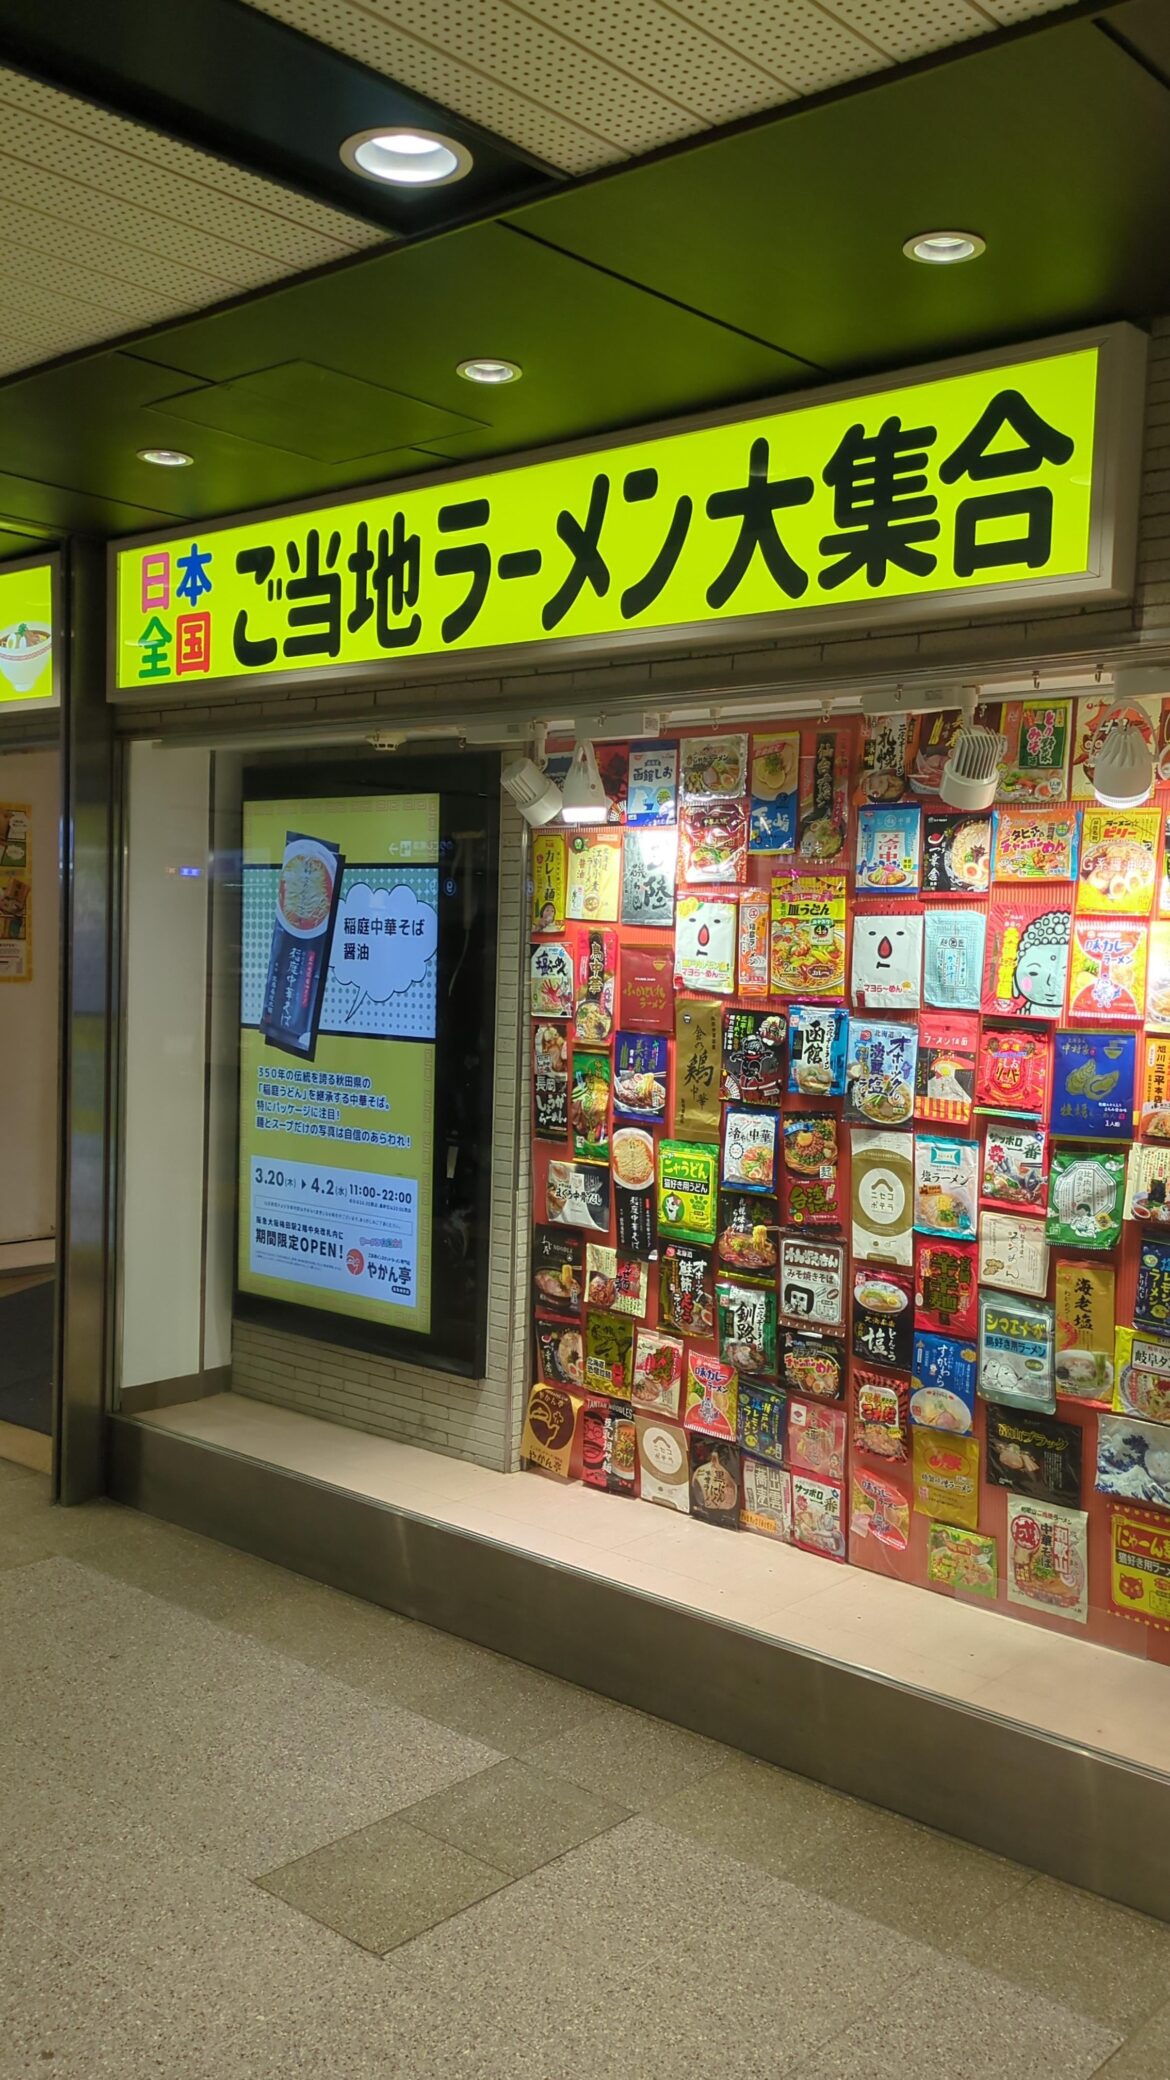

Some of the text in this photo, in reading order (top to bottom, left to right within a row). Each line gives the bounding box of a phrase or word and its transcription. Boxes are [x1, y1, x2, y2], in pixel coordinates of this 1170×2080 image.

[233, 388, 1075, 667] ご当地ラーメン大集合
[141, 543, 213, 613] 日本
[138, 611, 211, 679] 全国
[633, 767, 673, 782] 函館しお
[788, 903, 830, 916] 皿うどん
[343, 917, 425, 937] 稲庭中華そば
[343, 943, 370, 961] 醤油
[803, 1019, 825, 1065] 函館
[874, 1030, 895, 1039] 北海道
[257, 1066, 371, 1089] 350年の伝統を誇る秋田県の
[257, 1083, 391, 1111] 「稲庭うどん」を継承する中華そば。
[664, 1178, 709, 1194] 猫好き用うどん
[920, 1168, 970, 1186] 塩ラーメン
[349, 1184, 412, 1205] 11:00-22:00
[871, 1191, 895, 1201] ニセコ
[255, 1228, 345, 1260] 期間限定OPEN!
[675, 1248, 694, 1259] 北海道
[367, 1260, 412, 1286] やかん亭
[786, 1268, 834, 1284] みそ焼きそば
[1149, 1268, 1160, 1306] ラーメン
[1073, 1277, 1094, 1331] 海老塩
[861, 1326, 889, 1356] 塩
[936, 1344, 951, 1388] すがわら
[529, 1449, 562, 1473] やかん亭
